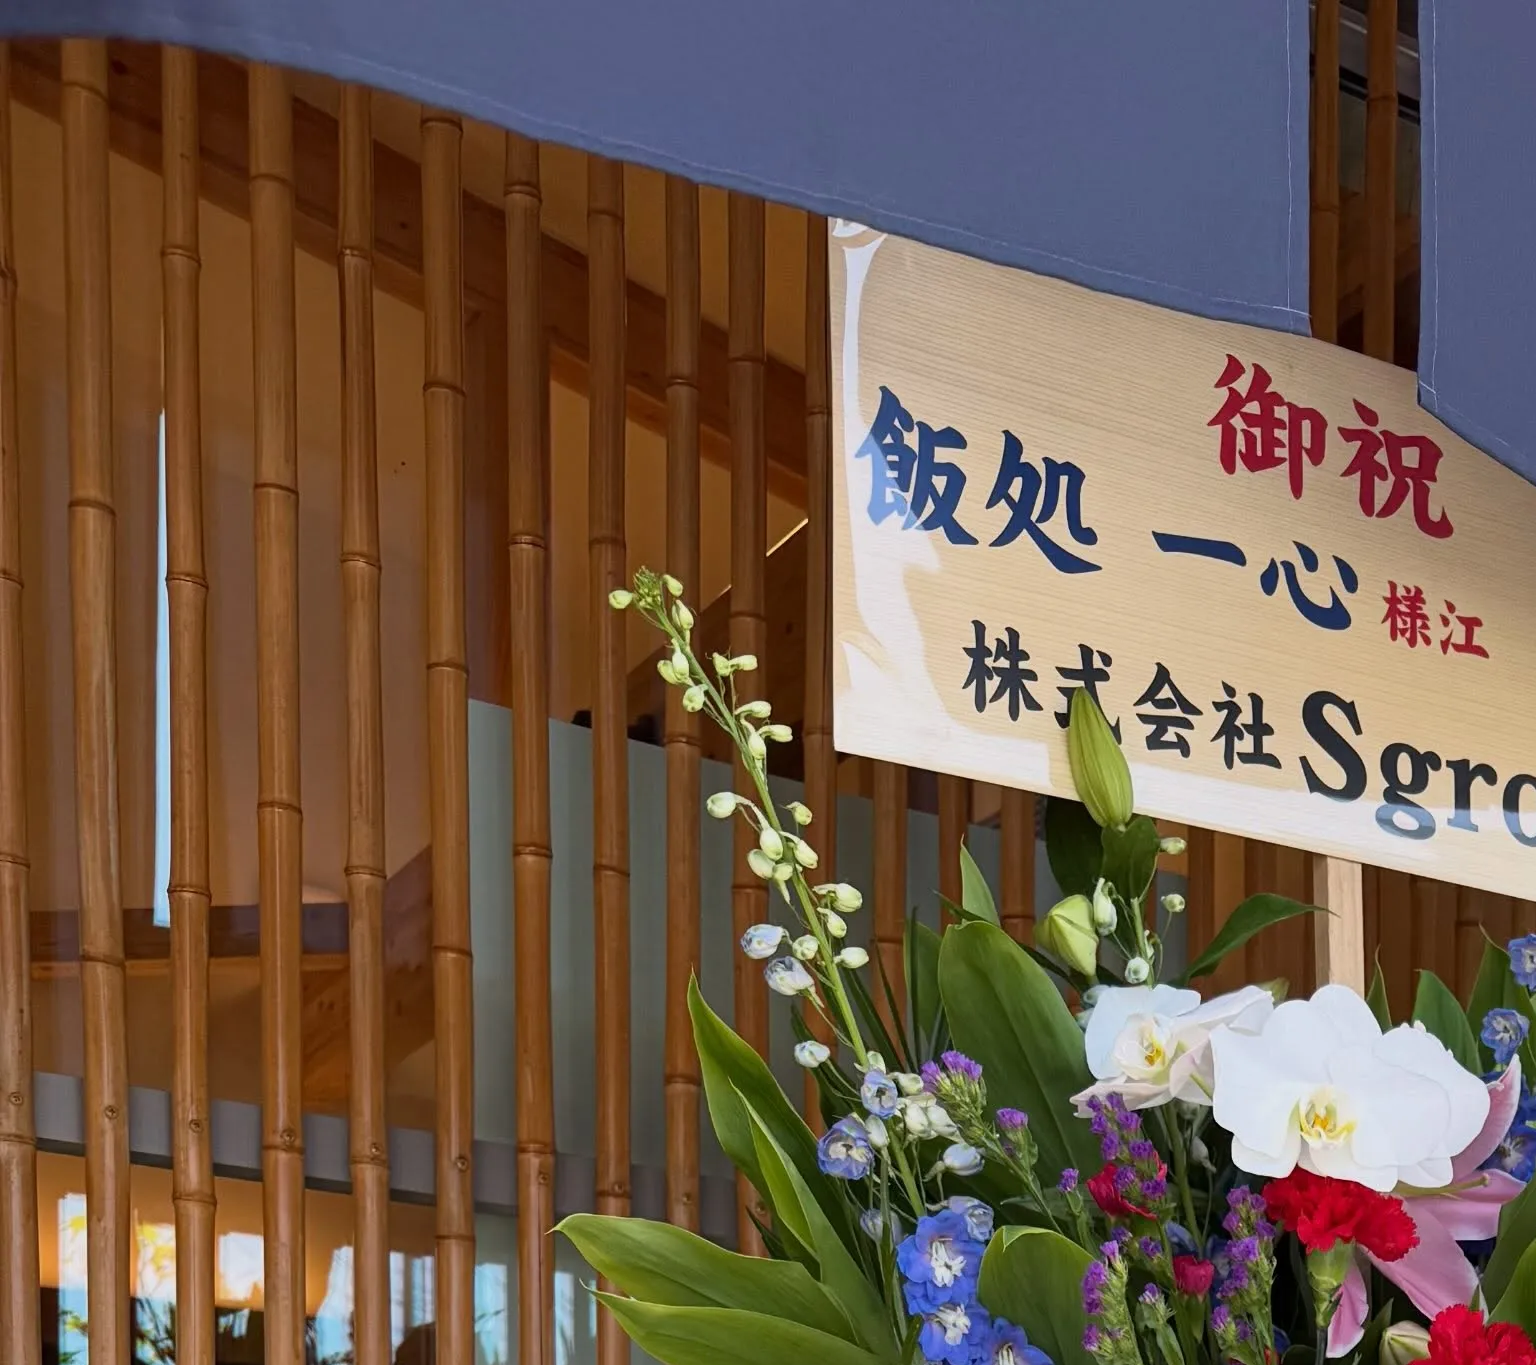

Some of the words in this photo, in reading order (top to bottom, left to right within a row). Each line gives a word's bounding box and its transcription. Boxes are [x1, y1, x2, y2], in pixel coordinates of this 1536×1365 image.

[855, 385, 1102, 574] 飯処
[1151, 530, 1359, 630] 一心
[1381, 580, 1491, 660] 様江
[1206, 353, 1454, 539] 御祝
[962, 619, 1282, 770] 株式会社
